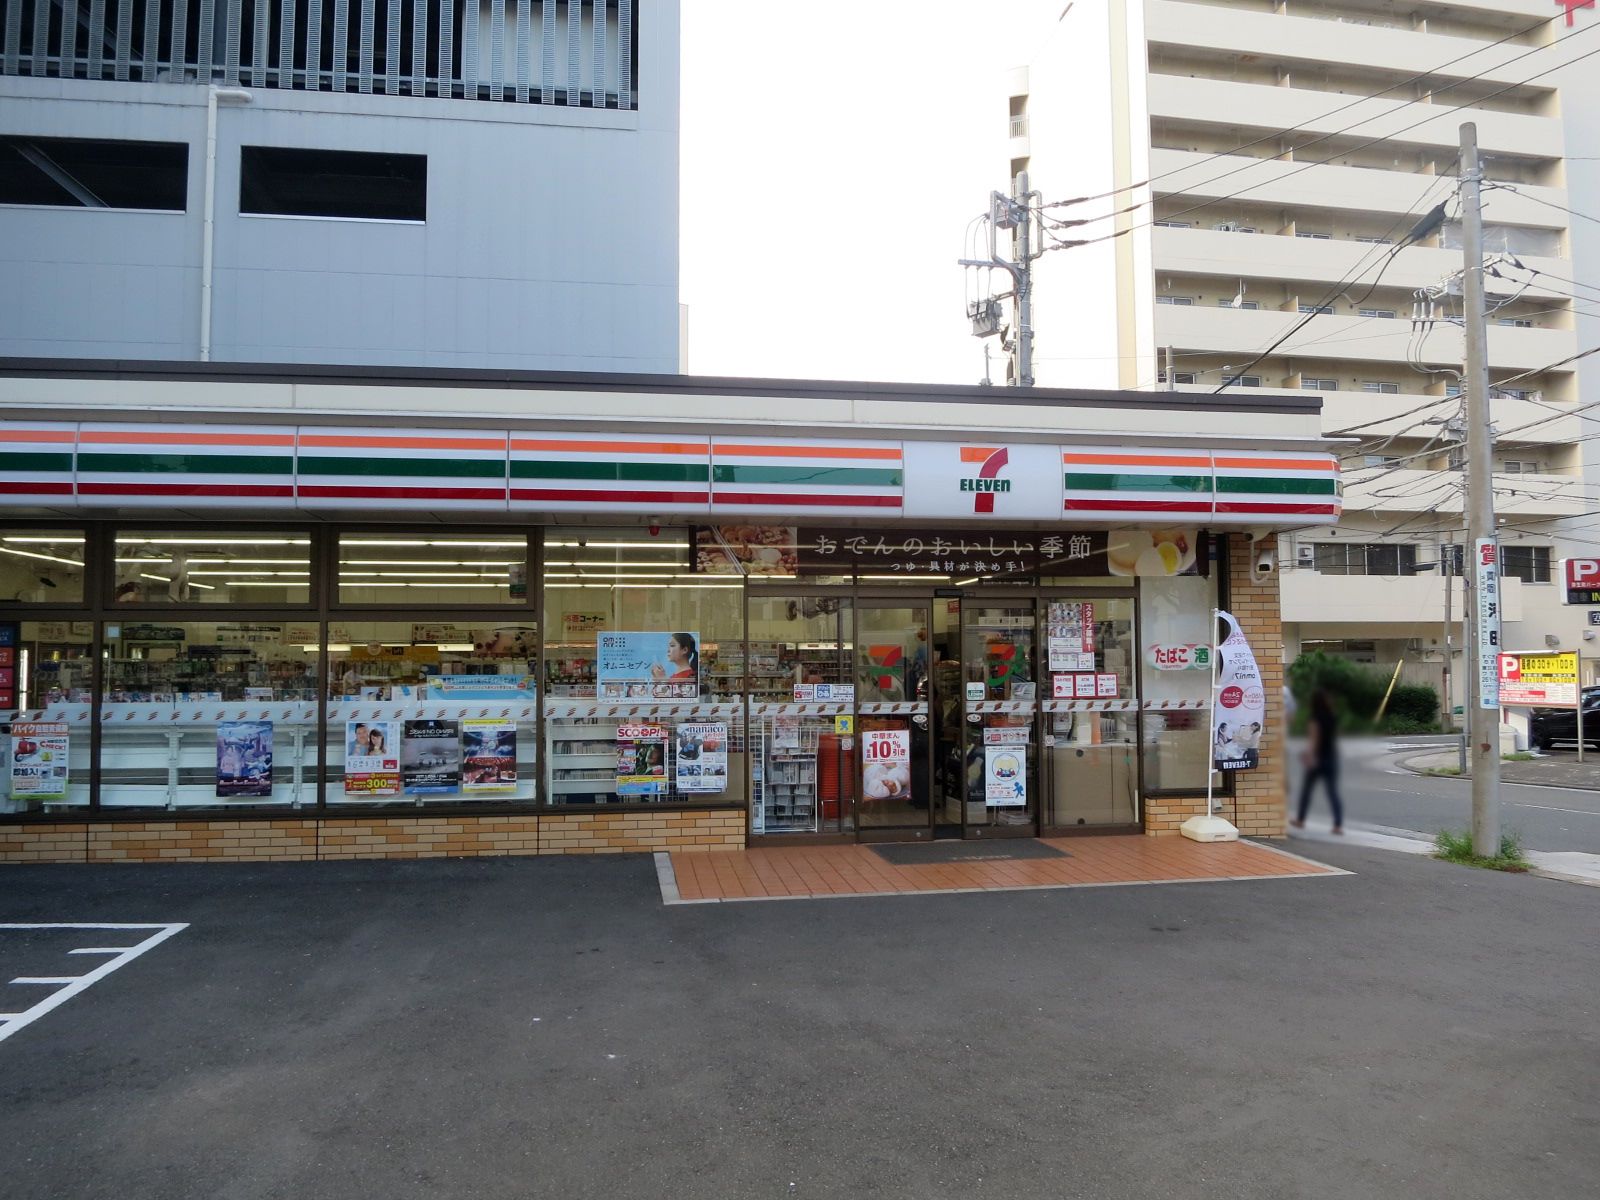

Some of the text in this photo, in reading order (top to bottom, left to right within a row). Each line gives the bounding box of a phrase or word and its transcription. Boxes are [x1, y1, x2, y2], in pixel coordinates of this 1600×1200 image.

[815, 534, 1092, 559] おでんのおいしい季節
[1574, 560, 1599, 581] P
[1155, 647, 1209, 664] たばこ 酒
[603, 661, 652, 670] オムニセブン
[1502, 657, 1518, 678] P
[617, 728, 660, 737] SCOOP!
[689, 725, 724, 734] nanaco
[871, 732, 900, 740] 中華まん
[869, 740, 891, 759] 10
[366, 779, 387, 788] 300
